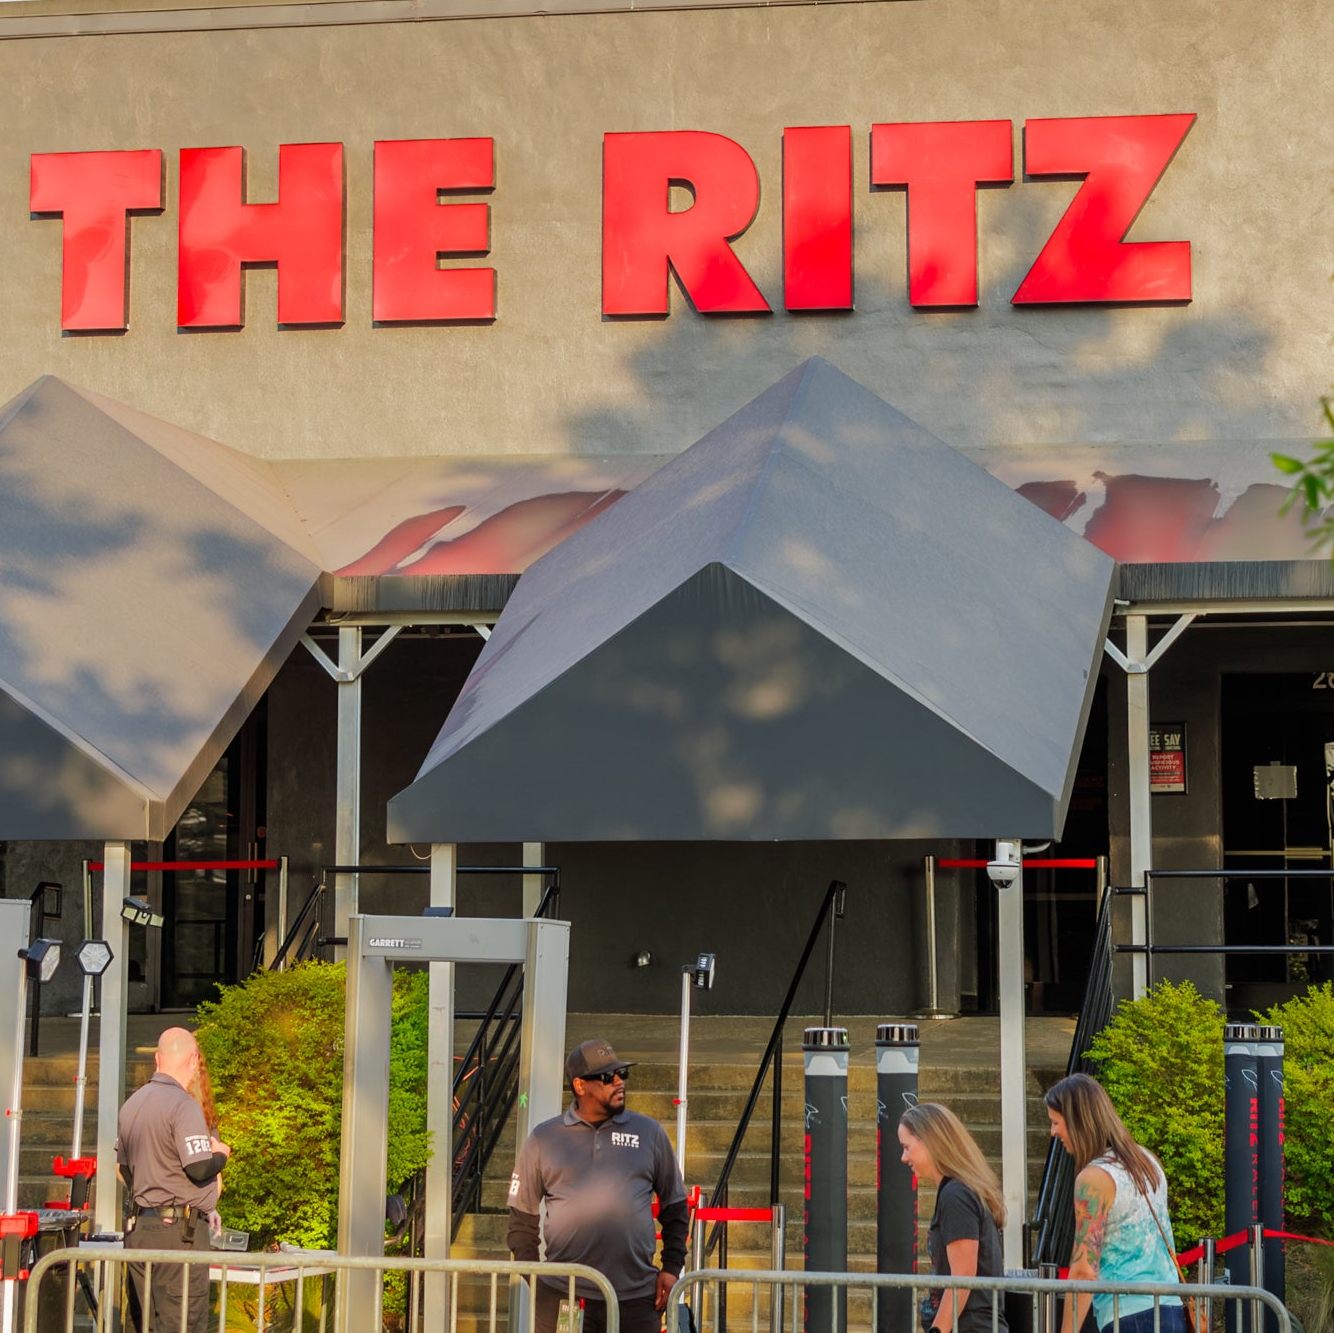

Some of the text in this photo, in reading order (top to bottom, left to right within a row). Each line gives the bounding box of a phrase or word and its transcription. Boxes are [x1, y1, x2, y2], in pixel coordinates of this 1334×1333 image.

[29, 113, 1198, 335] THE RITZ
[1150, 733, 1181, 746] EE SAY
[369, 938, 405, 947] GARRETT
[611, 1131, 640, 1145] RITZ
